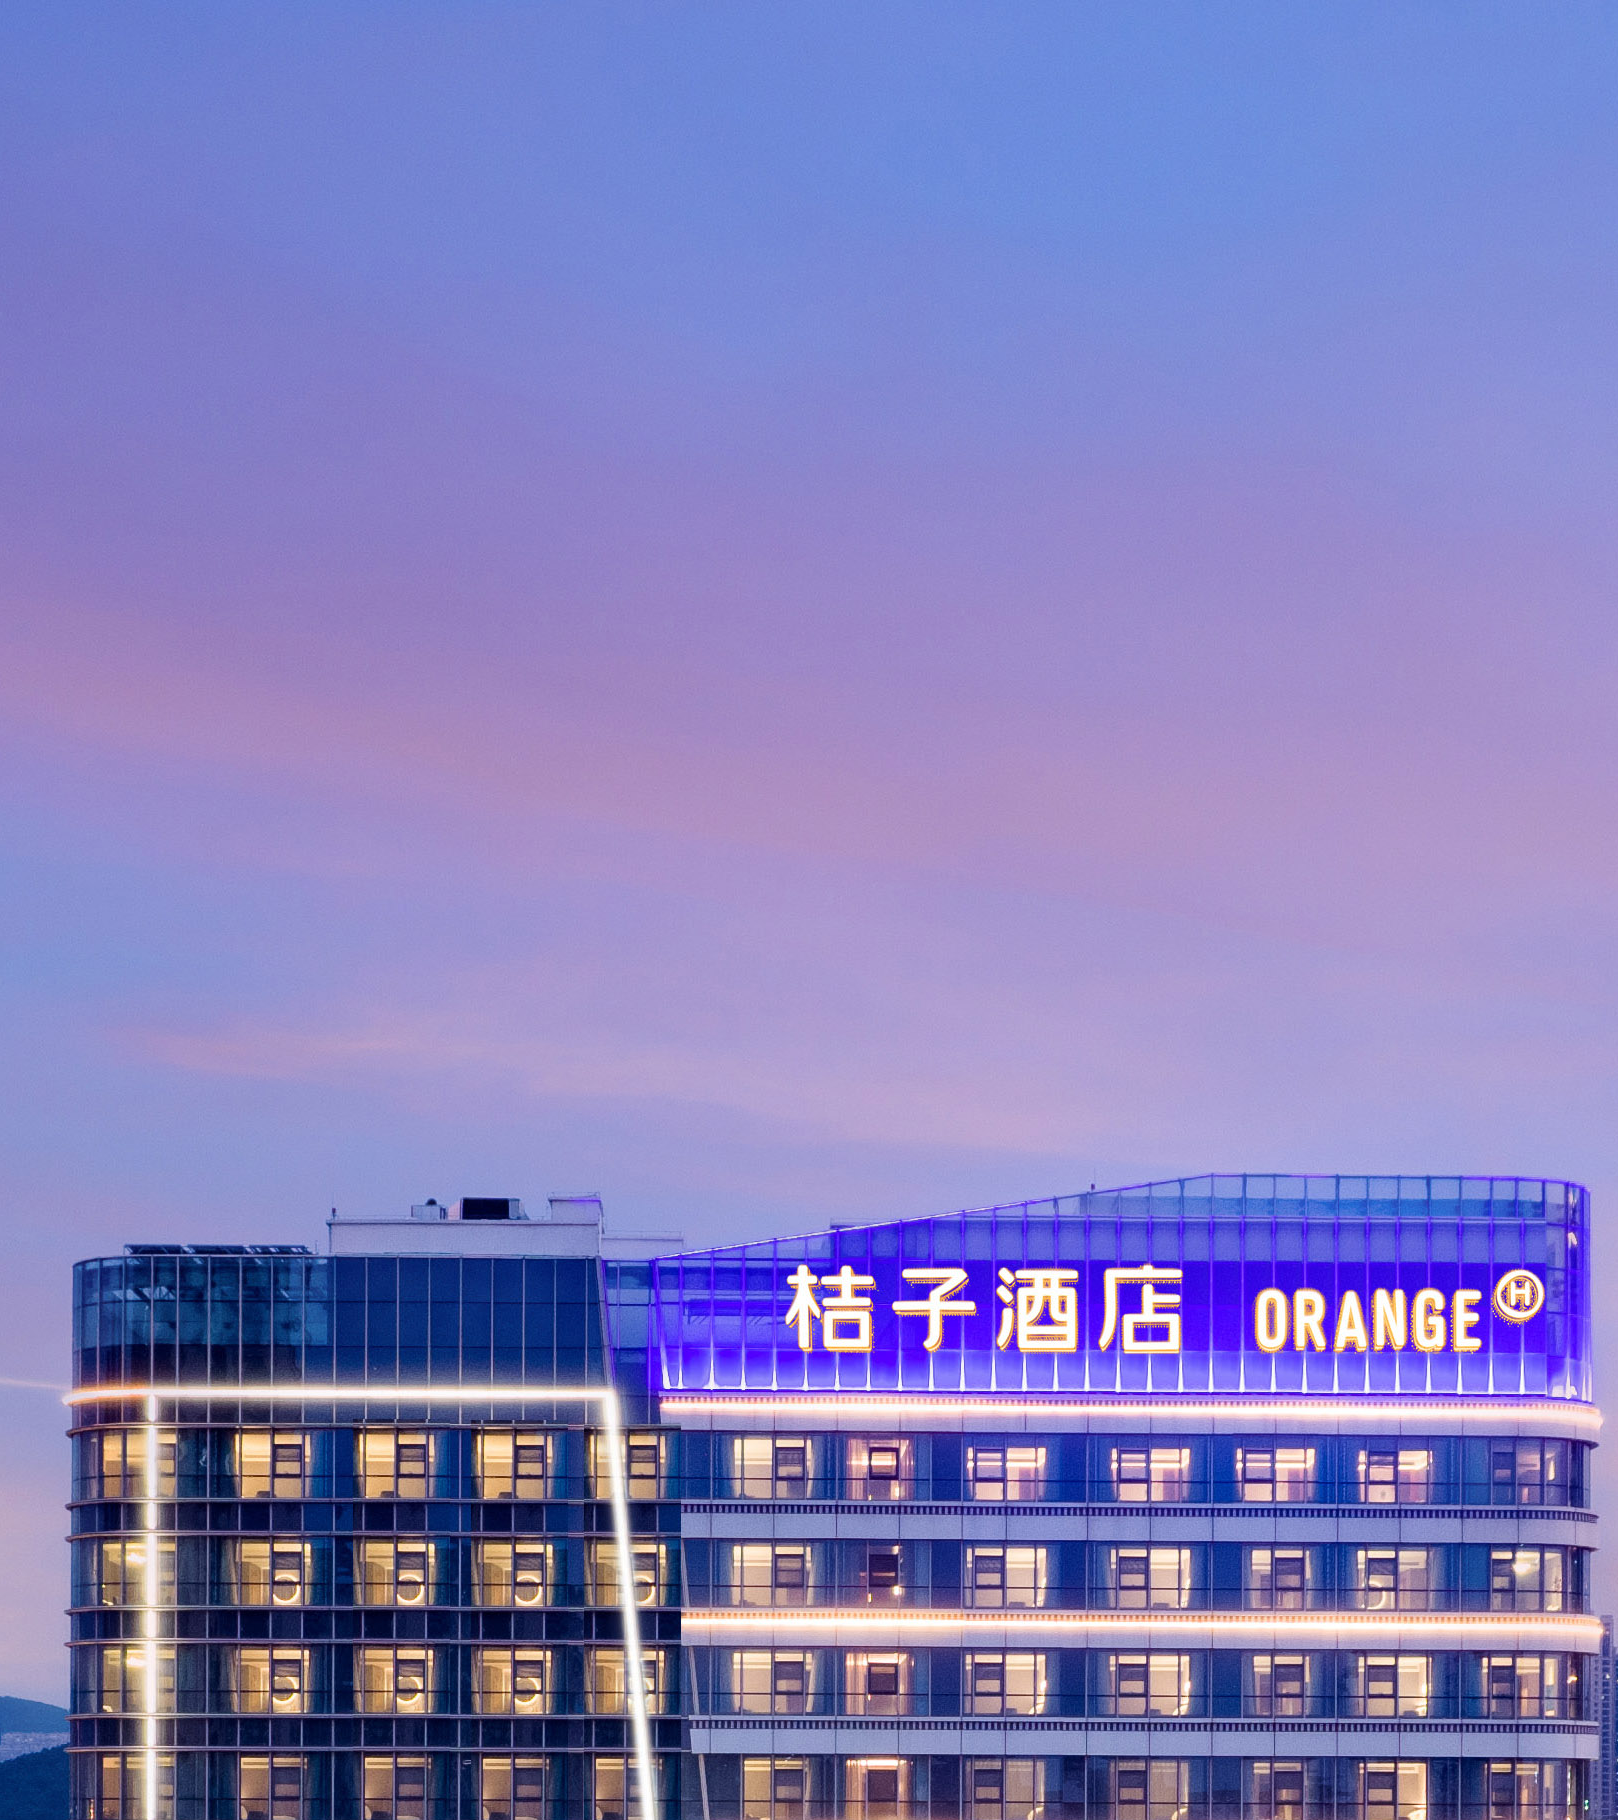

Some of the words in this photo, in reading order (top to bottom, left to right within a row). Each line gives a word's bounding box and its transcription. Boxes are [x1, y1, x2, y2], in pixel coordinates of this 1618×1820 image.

[784, 1263, 1184, 1354] 桔子酒店
[1255, 1287, 1483, 1353] ORANGE
